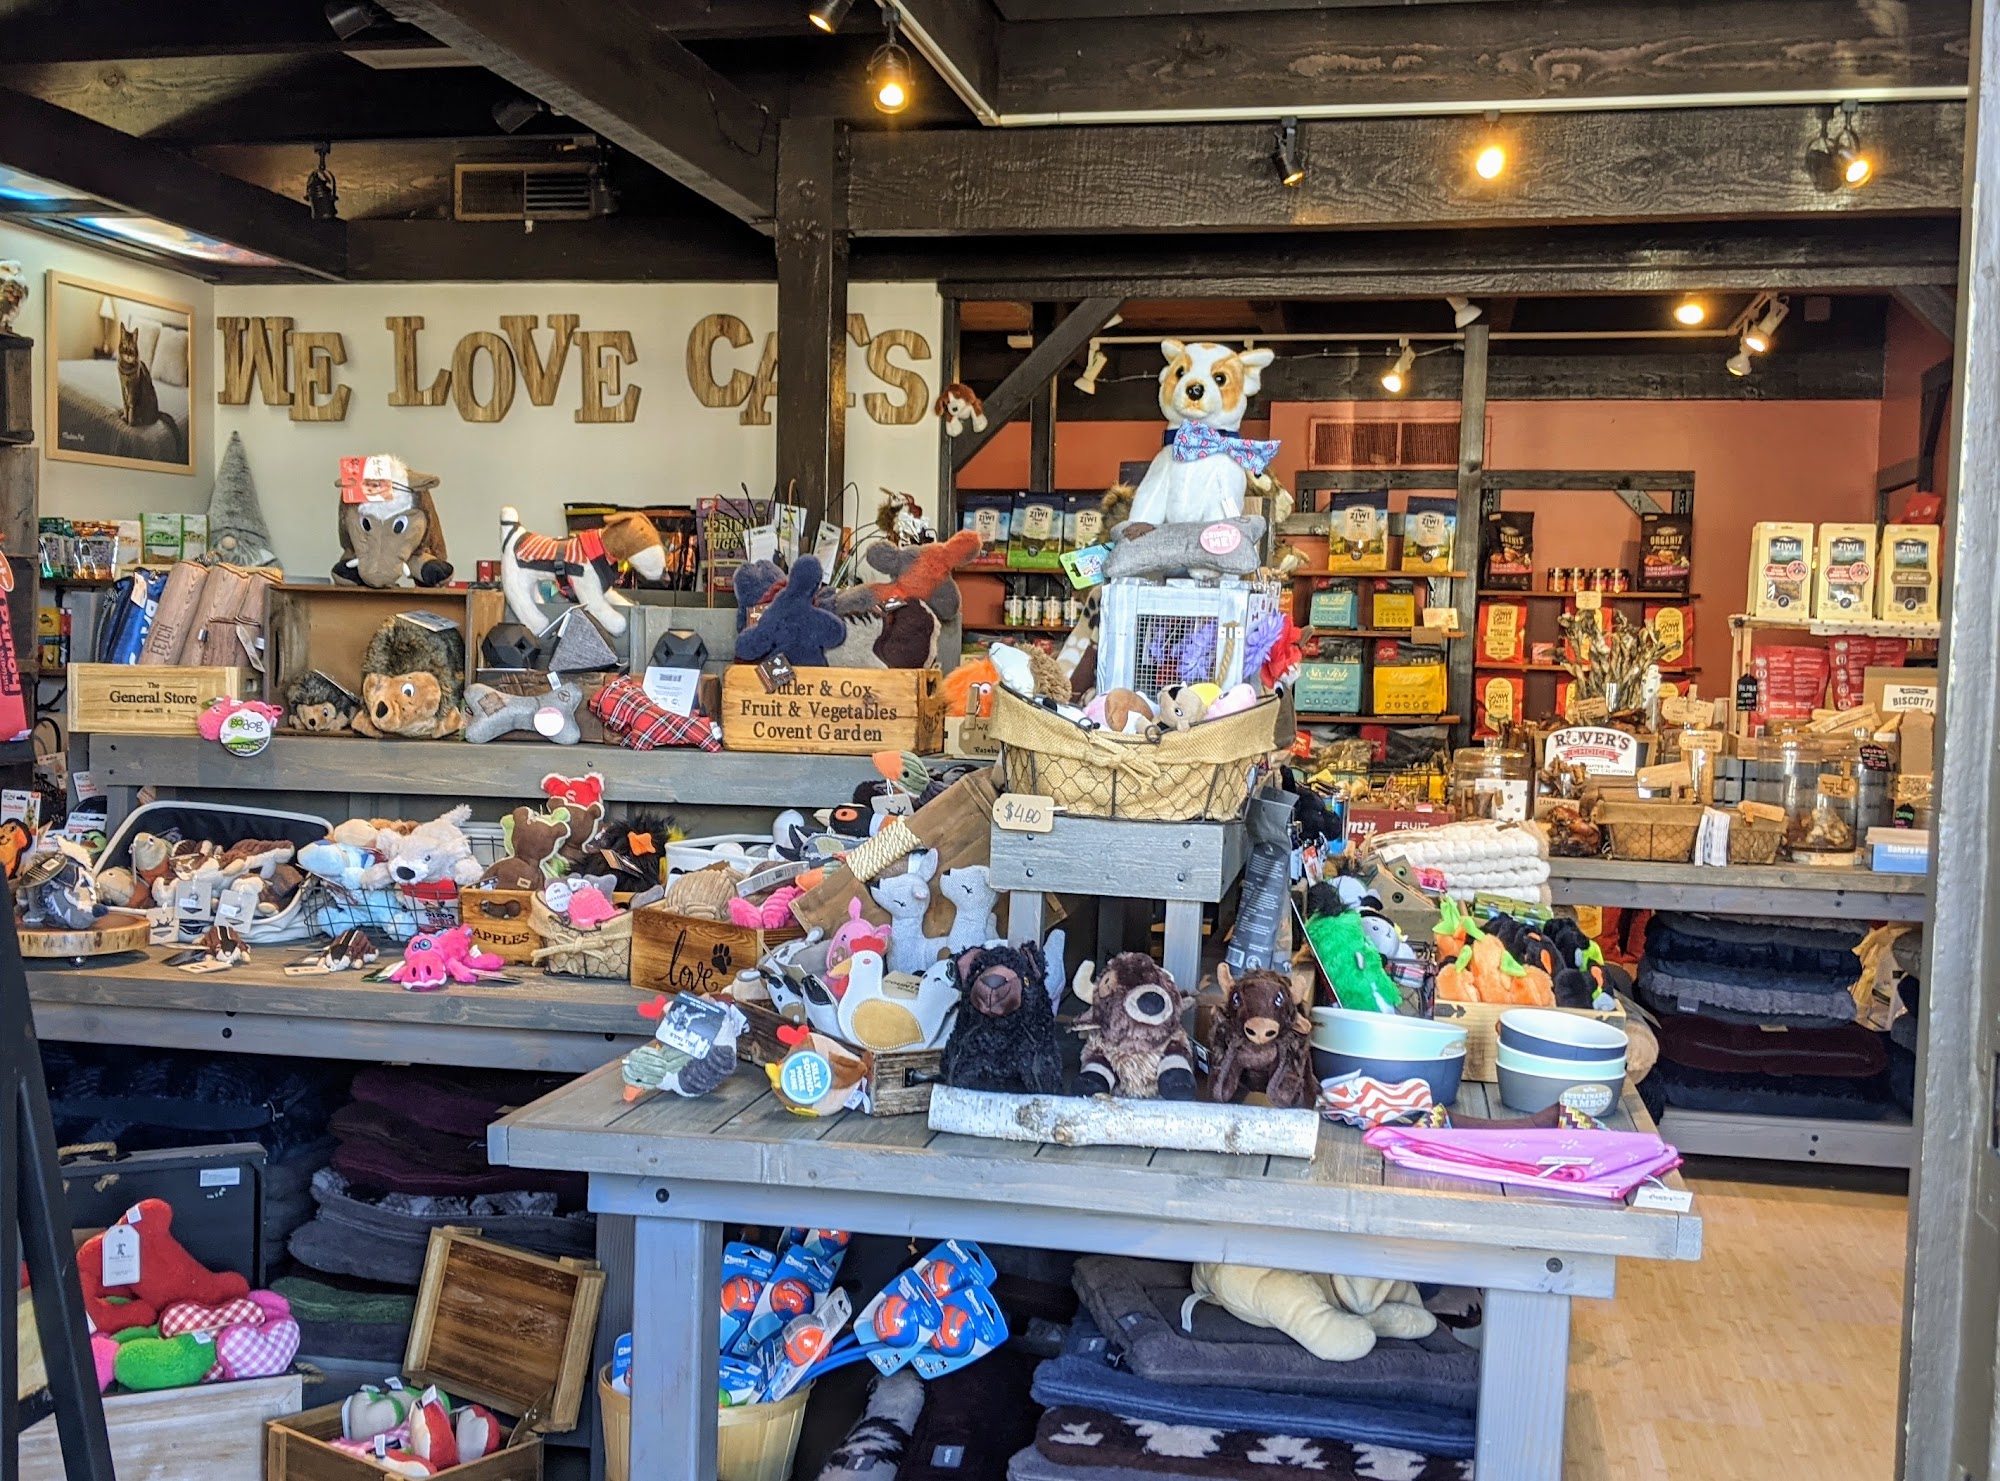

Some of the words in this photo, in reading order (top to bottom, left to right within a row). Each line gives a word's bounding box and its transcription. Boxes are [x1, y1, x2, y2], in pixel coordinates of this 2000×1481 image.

[216, 316, 352, 422] WE
[386, 313, 642, 423] LOVE
[686, 312, 932, 426] CAS
[978, 514, 995, 522] ZIWI
[1029, 511, 1048, 519] ZIWI
[1080, 515, 1097, 524] ZIWI
[1421, 518, 1440, 526] ZIWI
[1649, 535, 1683, 546] ORGANIX
[1776, 542, 1797, 551] ZIWI
[1838, 542, 1859, 551] ZIWI
[1901, 545, 1922, 553] ZIWI
[150, 624, 174, 656] FETCH
[765, 678, 815, 696] utler
[819, 680, 833, 696] &
[840, 680, 873, 698] Cox
[109, 691, 160, 704] General
[164, 692, 197, 704] Store
[1892, 696, 1935, 708] BISCOTTI
[741, 700, 783, 717] Fruit
[788, 701, 801, 718] &
[808, 702, 898, 723] Vegetables
[753, 721, 813, 740] Covent
[818, 723, 883, 742] Garden
[1003, 801, 1042, 824] $4.00
[1394, 821, 1430, 830] FRUIT
[472, 927, 530, 945] APPLES
[654, 928, 720, 993] love
